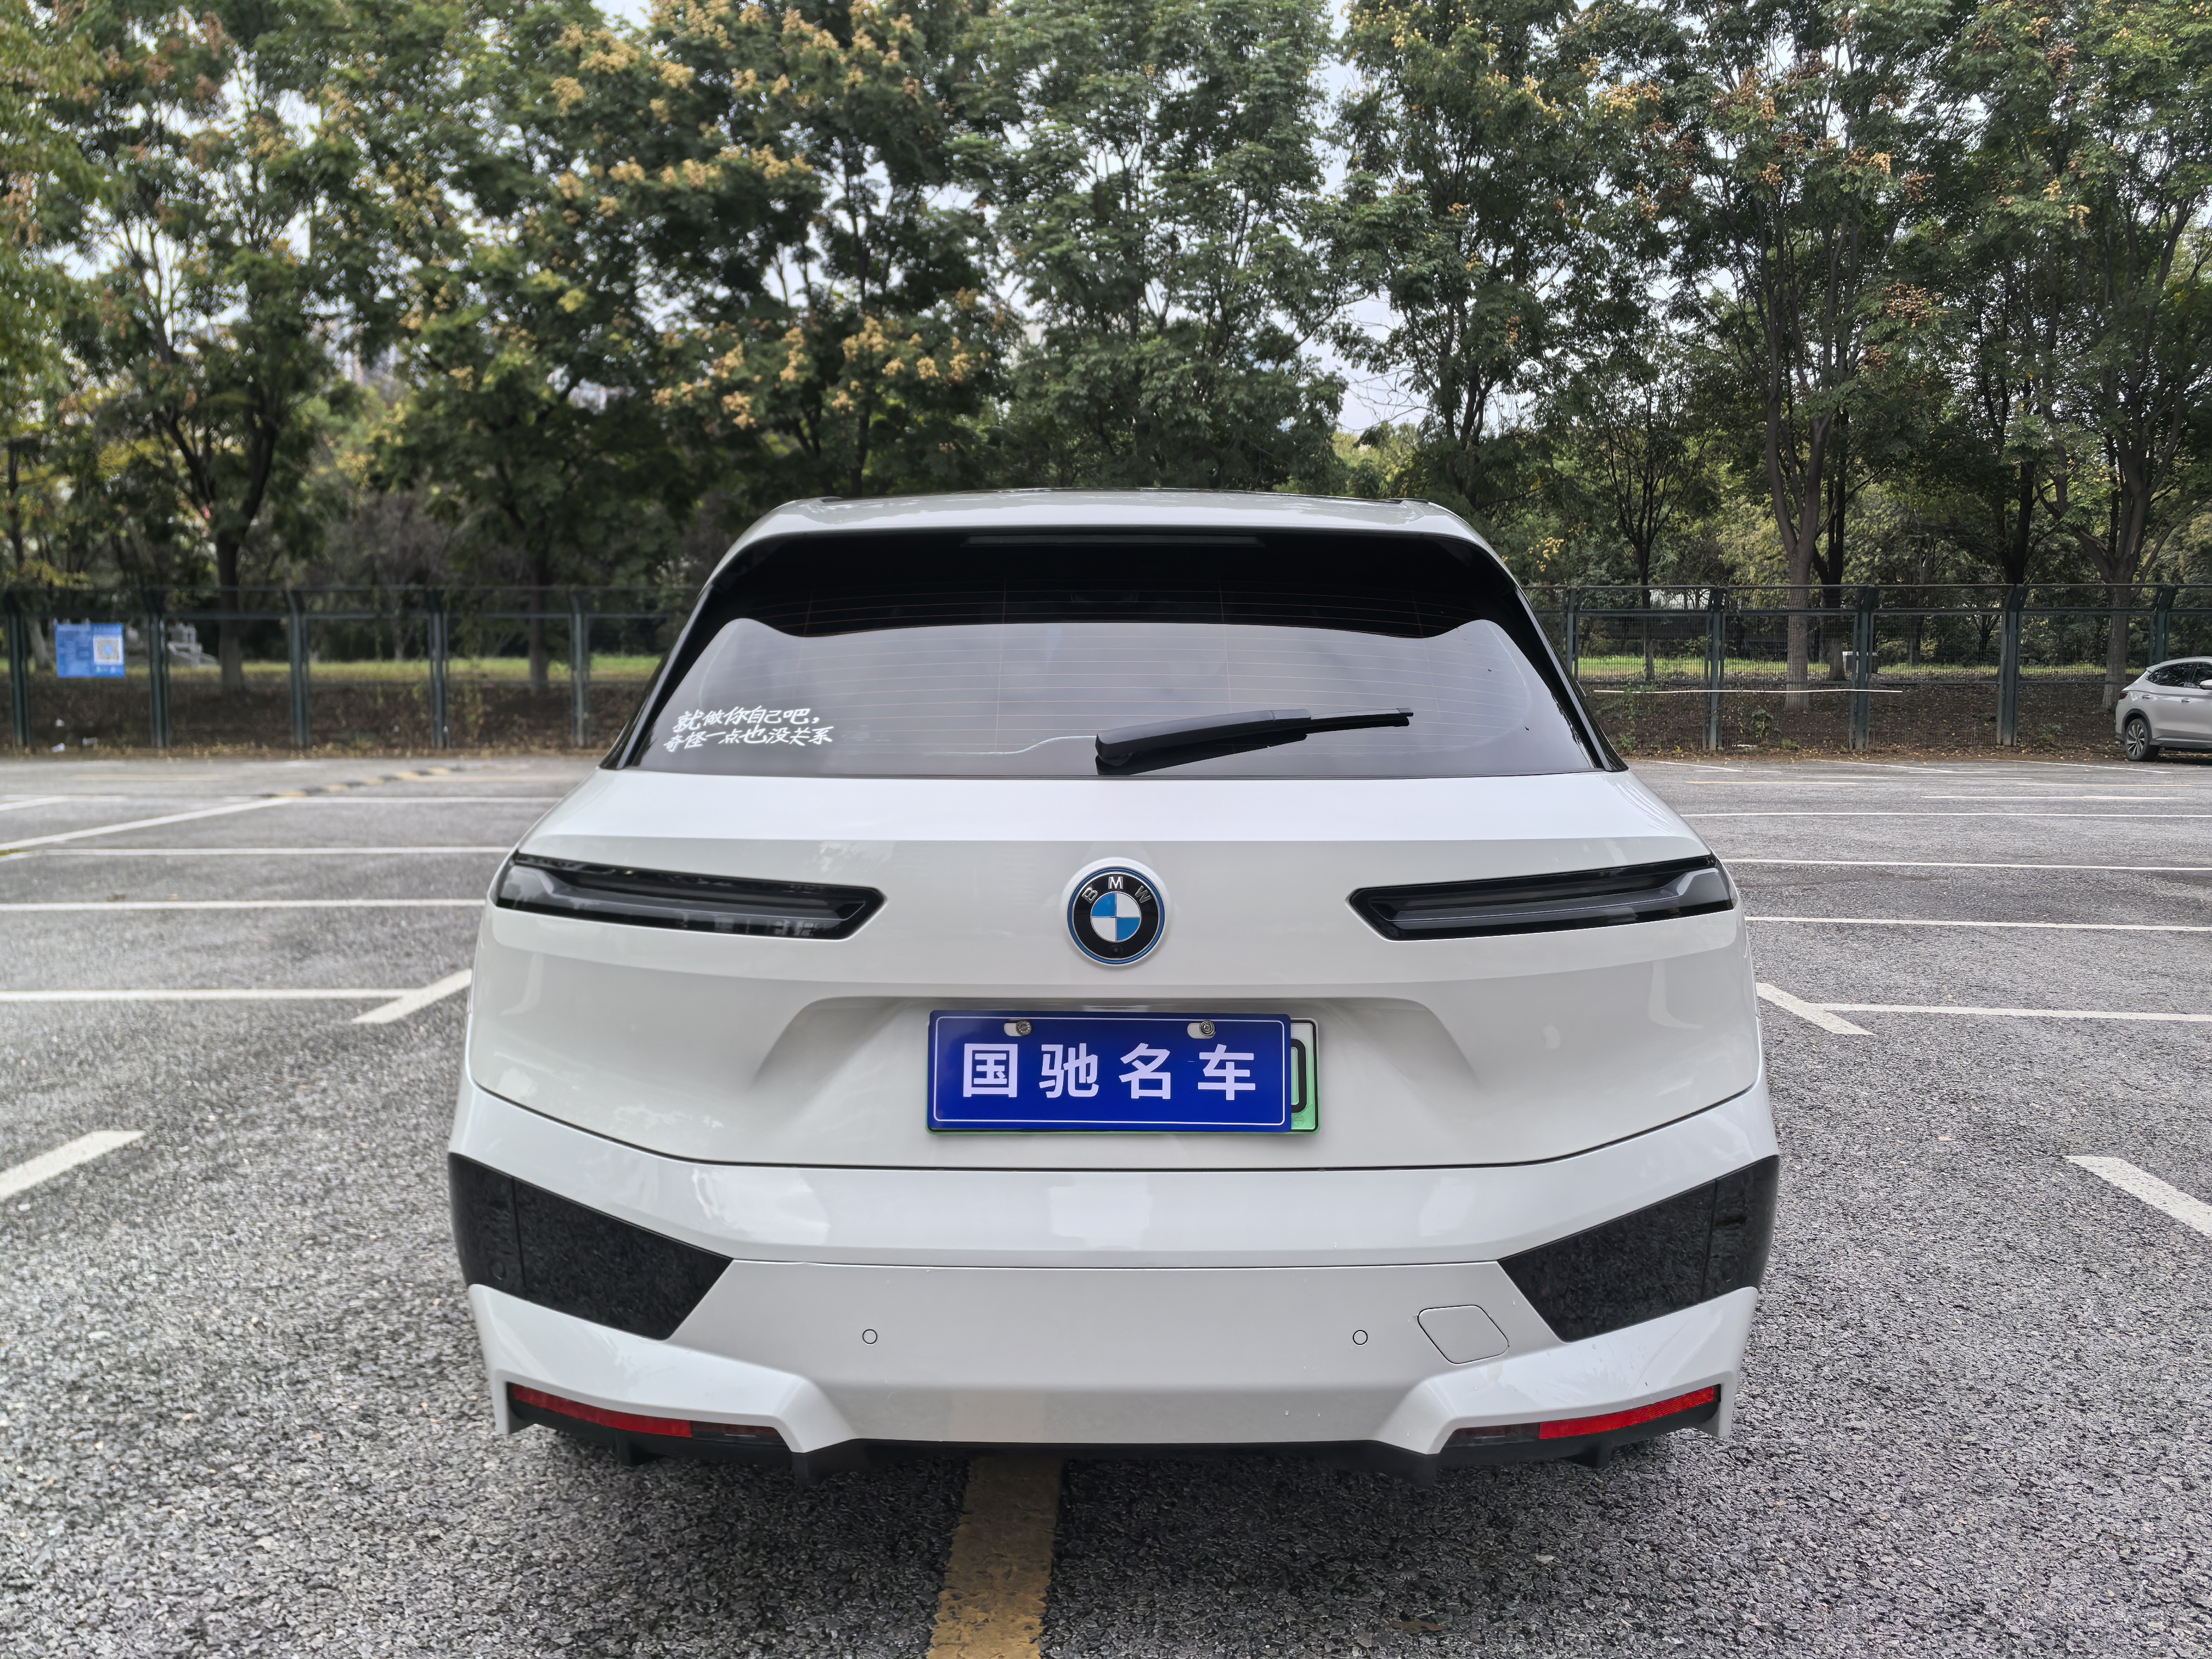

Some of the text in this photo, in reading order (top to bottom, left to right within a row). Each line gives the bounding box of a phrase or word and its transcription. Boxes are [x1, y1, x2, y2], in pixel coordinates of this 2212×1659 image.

[663, 724, 834, 752] 奇怪一点也没关系
[1082, 875, 1152, 904] BMW
[963, 1042, 1256, 1101] 国驰名车
